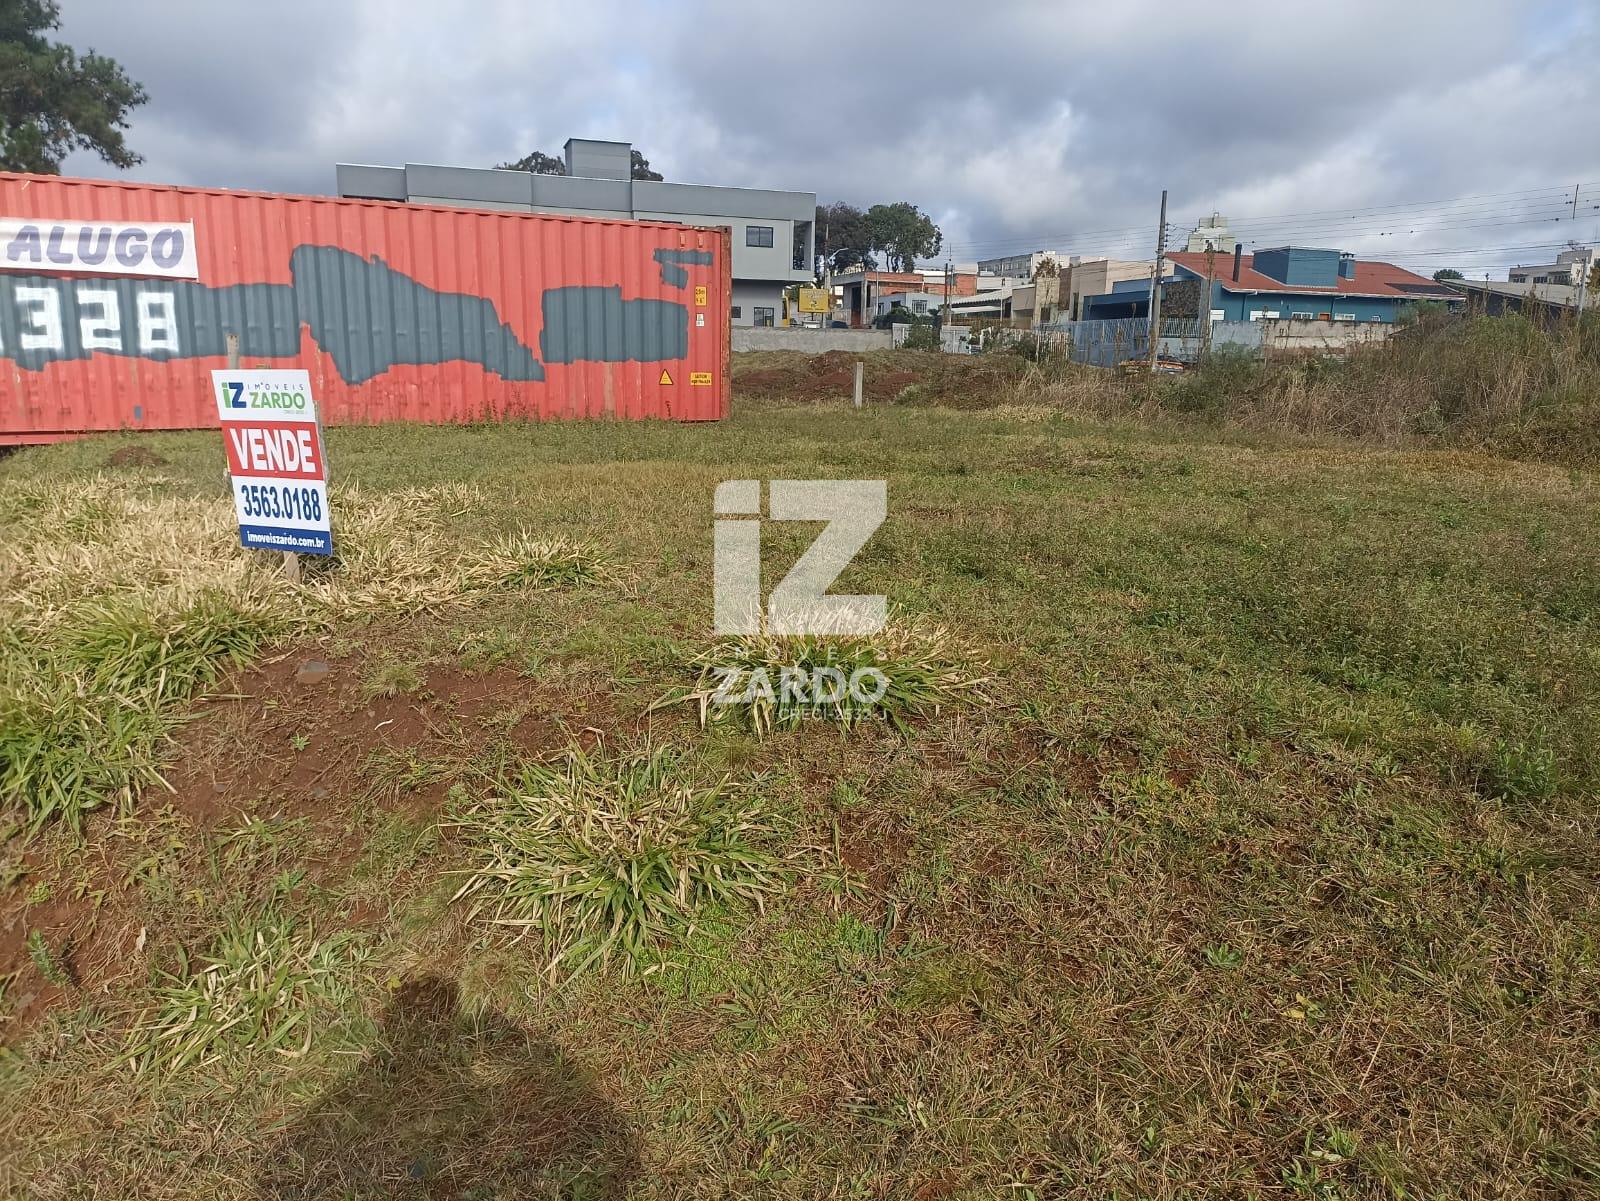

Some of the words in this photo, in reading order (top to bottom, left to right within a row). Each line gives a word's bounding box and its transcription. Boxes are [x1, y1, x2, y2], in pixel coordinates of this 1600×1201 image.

[7, 225, 185, 269] ALUGO
[0, 286, 179, 351] 328
[249, 391, 306, 410] ZARDO
[229, 428, 316, 473] VENDE
[241, 484, 322, 521] 3563.0188
[246, 530, 325, 548] imoveiszardo.com.br
